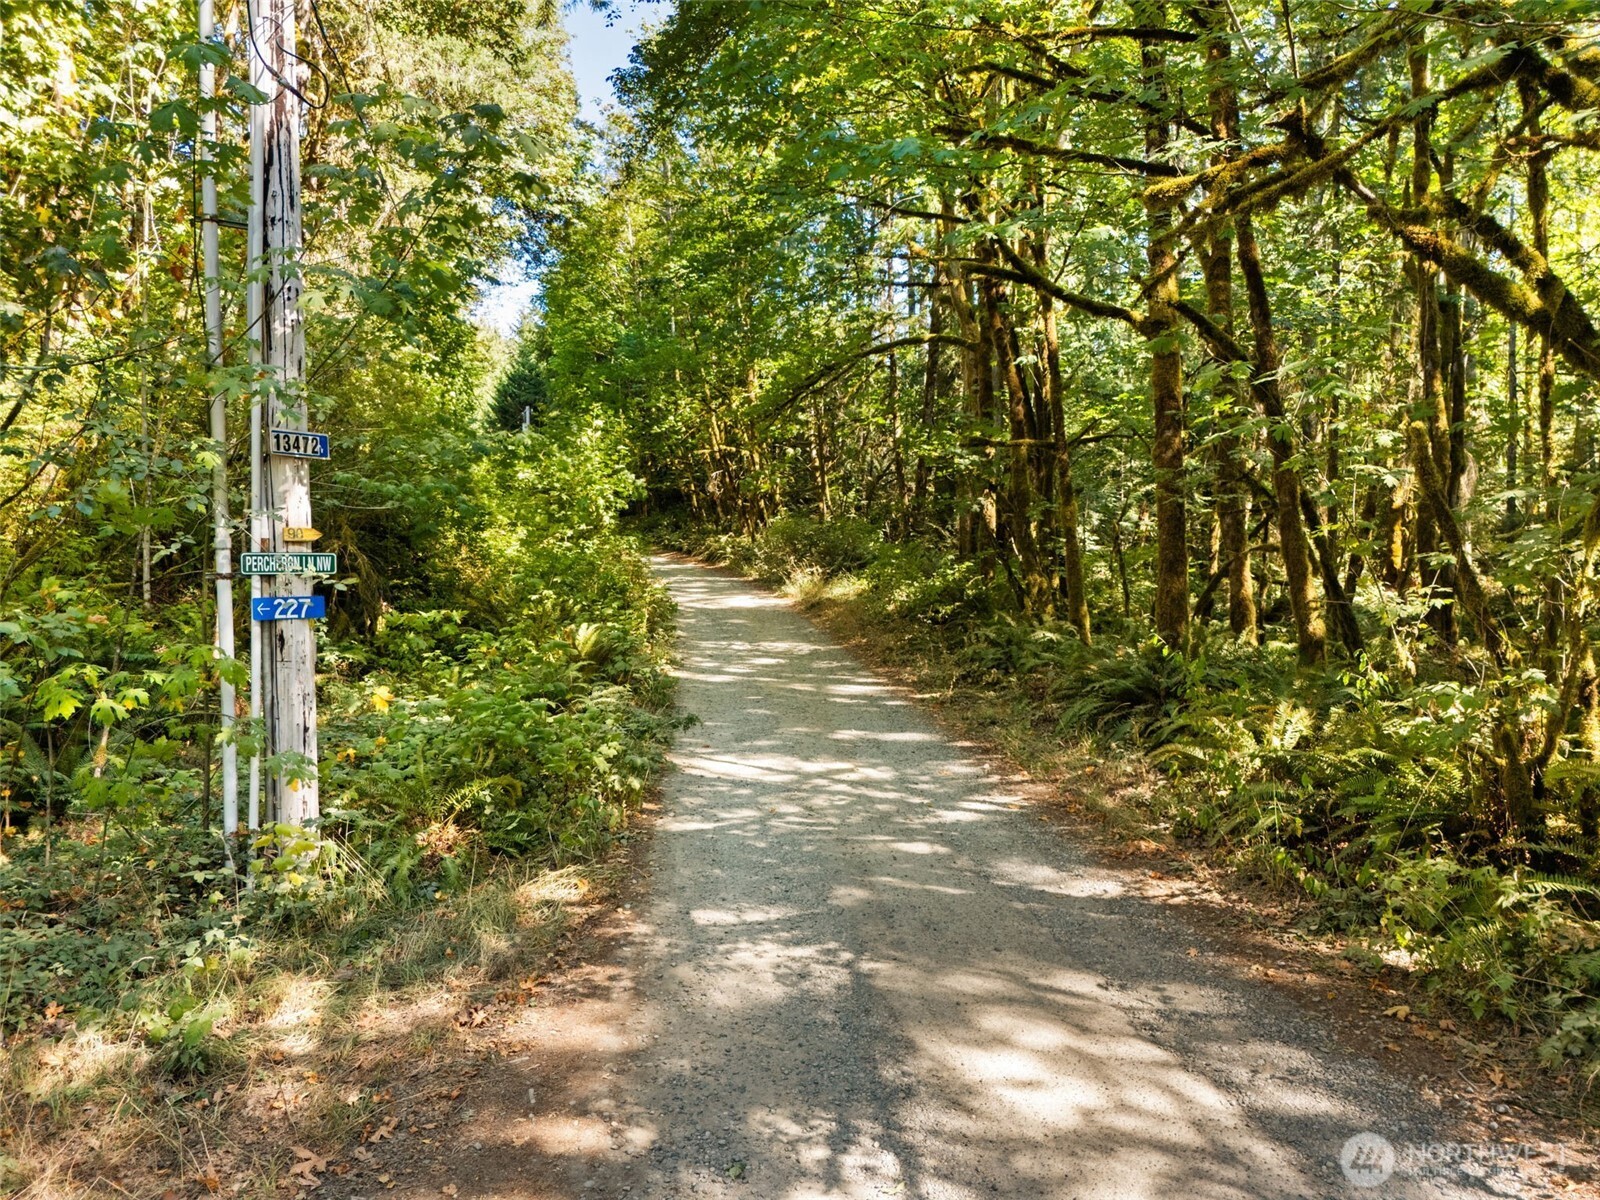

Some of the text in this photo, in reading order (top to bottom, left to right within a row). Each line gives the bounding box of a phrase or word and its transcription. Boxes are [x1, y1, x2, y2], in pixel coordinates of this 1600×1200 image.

[274, 433, 319, 455] 13472
[316, 556, 332, 572] NW
[273, 599, 311, 619] 227
